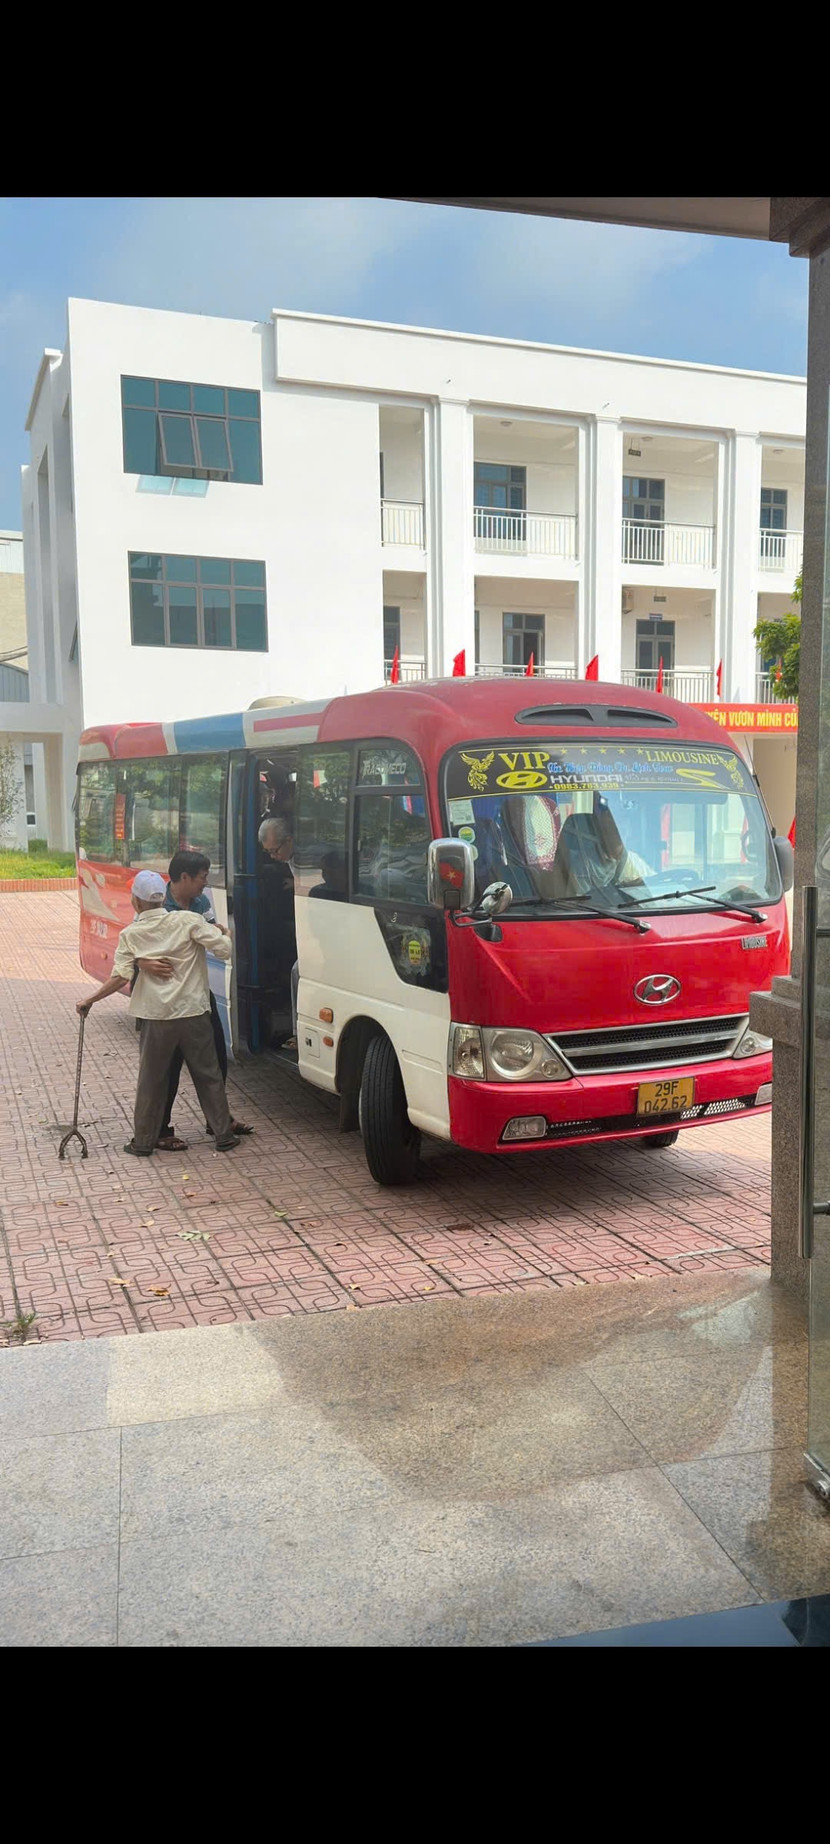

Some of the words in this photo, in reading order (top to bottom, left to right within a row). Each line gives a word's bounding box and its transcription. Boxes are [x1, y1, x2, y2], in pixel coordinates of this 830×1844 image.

[757, 709, 782, 726] MÌNH
[784, 708, 798, 726] CỦ
[498, 752, 550, 770] VIP
[645, 750, 720, 765] LIMOUSINE
[550, 774, 623, 784] HYUNDAI
[655, 1081, 679, 1097] 29F
[644, 1095, 688, 1114] 042.62
